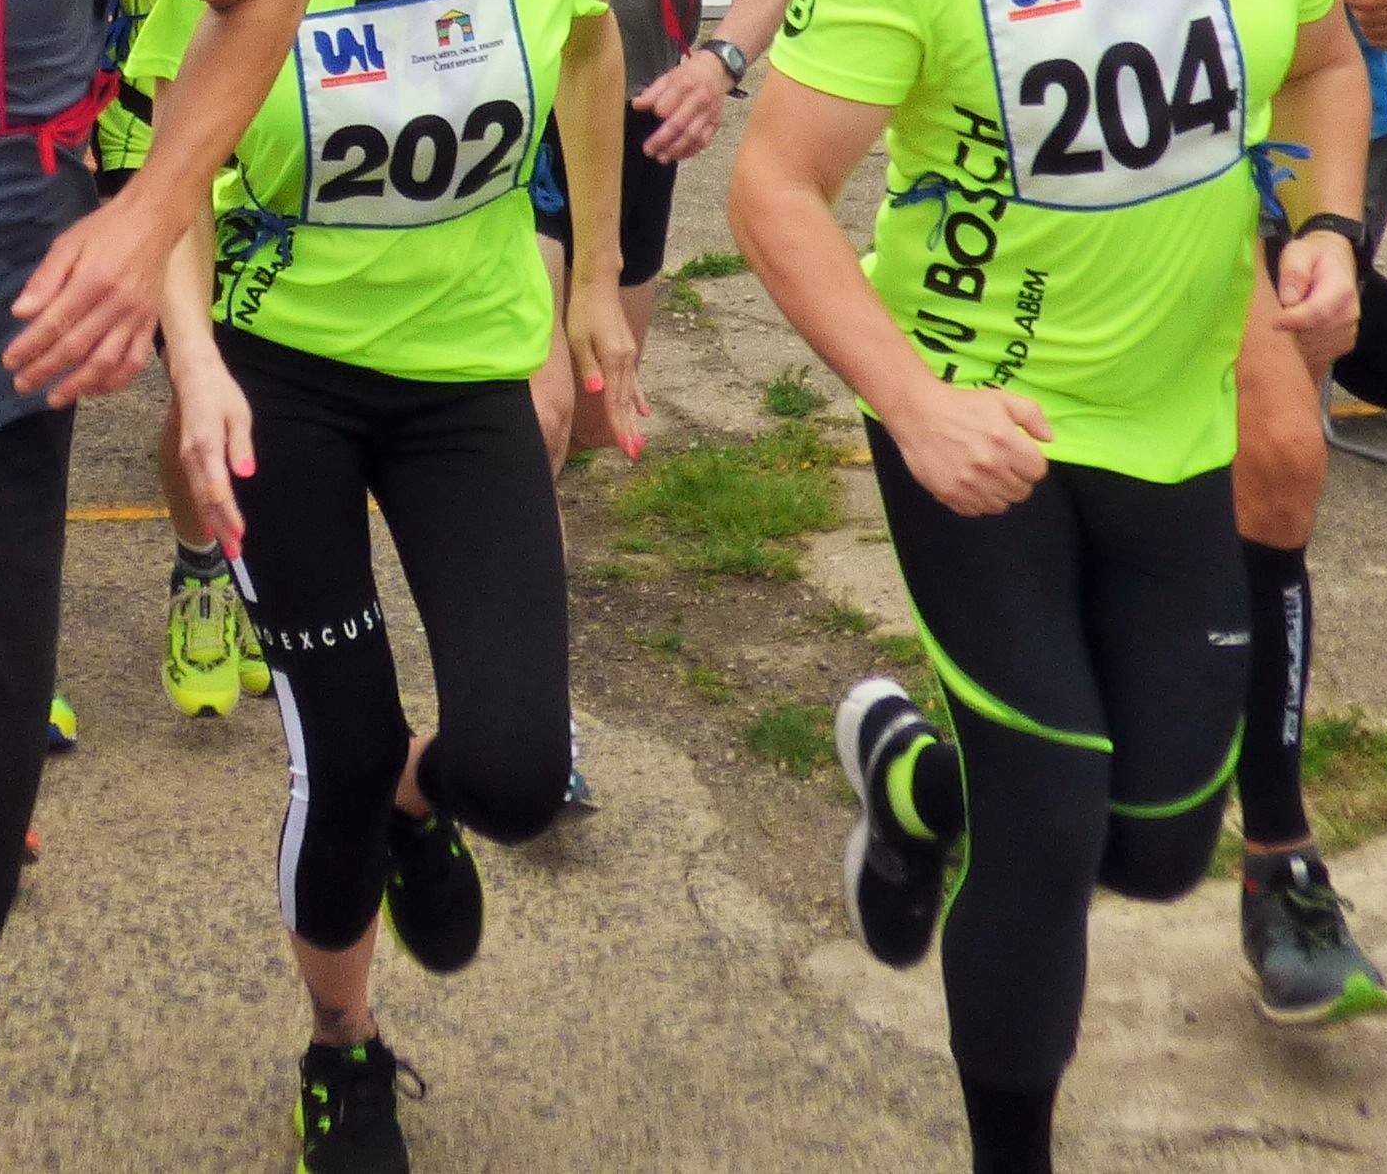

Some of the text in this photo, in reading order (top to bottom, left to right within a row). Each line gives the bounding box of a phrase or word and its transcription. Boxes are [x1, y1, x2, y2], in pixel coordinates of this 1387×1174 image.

[315, 99, 524, 204] 202
[1018, 16, 1239, 177] 204
[923, 104, 1014, 304] BOSCH
